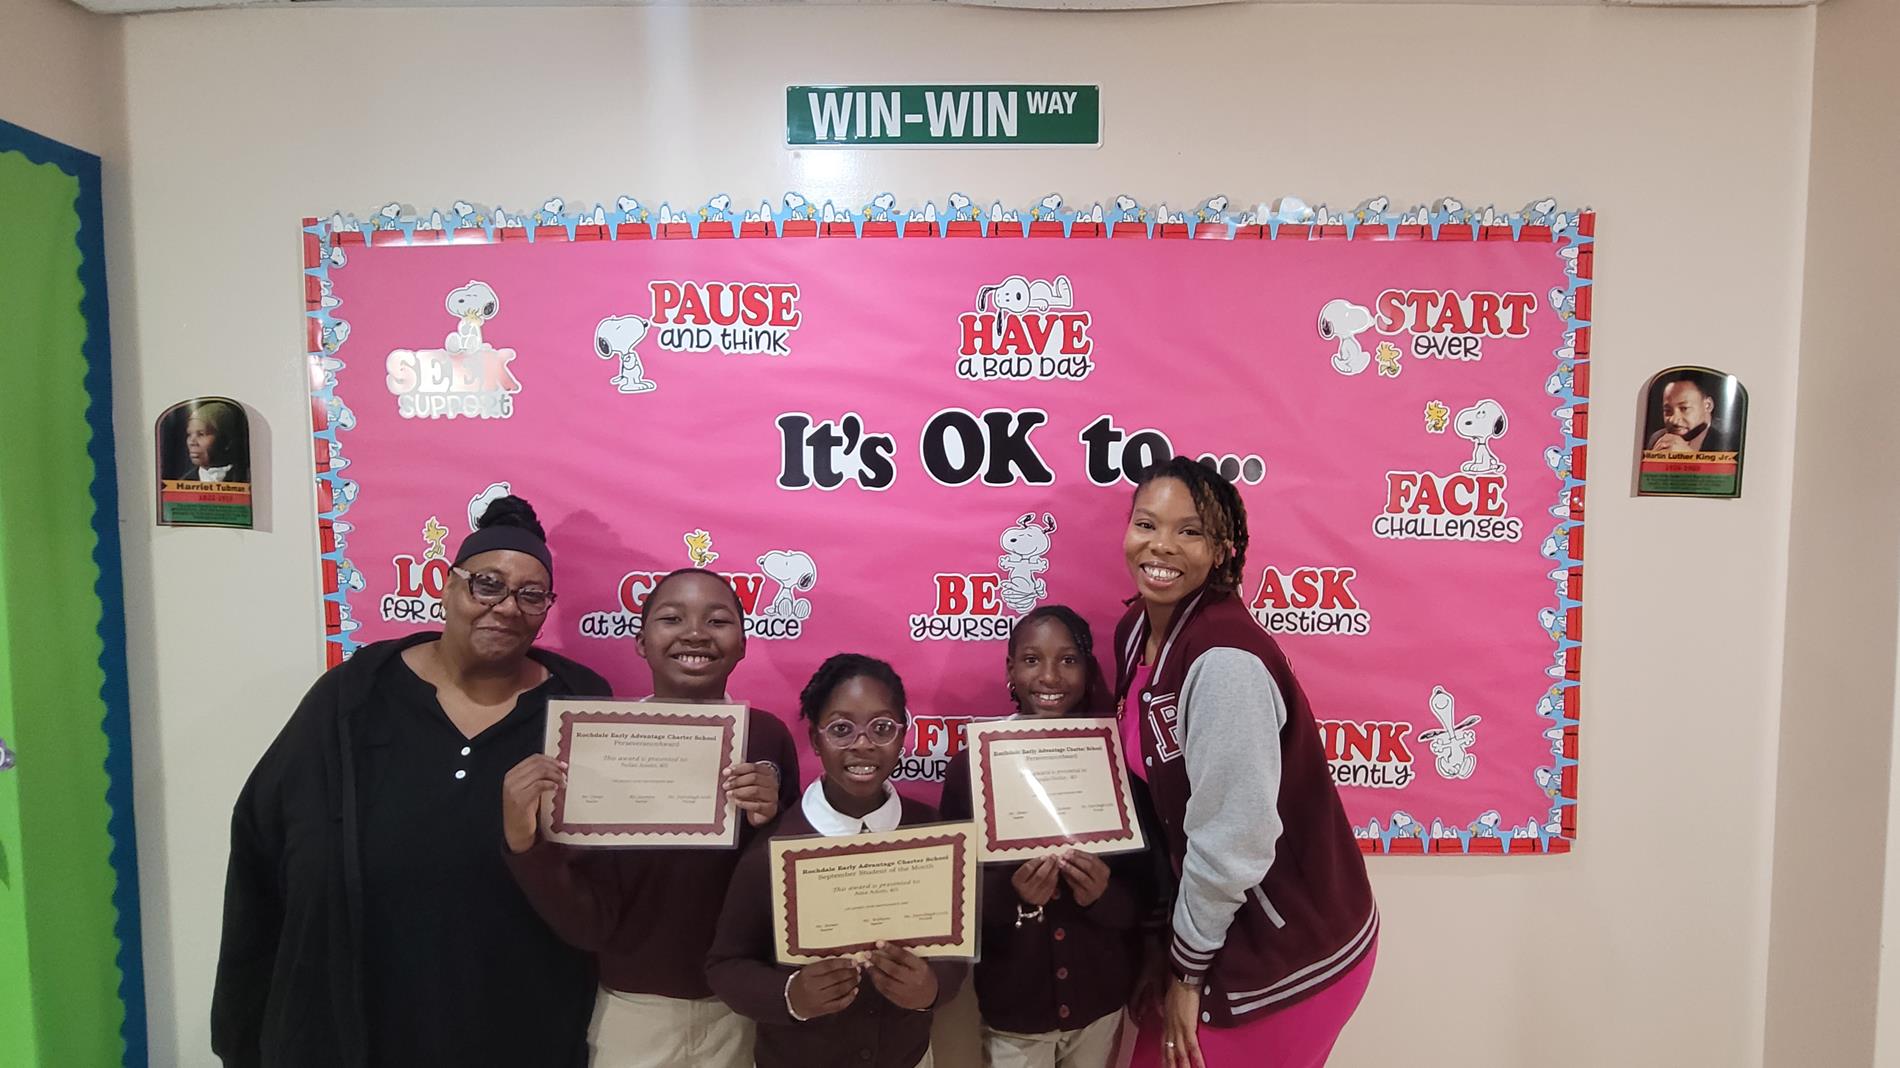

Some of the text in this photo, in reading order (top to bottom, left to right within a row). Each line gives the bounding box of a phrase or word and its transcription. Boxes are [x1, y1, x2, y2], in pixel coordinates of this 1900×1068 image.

[808, 91, 1078, 139] WIN-WIN WAY
[650, 282, 800, 327] PAUSE
[1377, 291, 1536, 335] START
[960, 314, 1091, 355] HAVE
[387, 350, 520, 392] SEEK
[778, 414, 895, 489] It's
[922, 410, 1053, 485] OK
[1081, 416, 1171, 484] to
[1386, 473, 1505, 516] FACE
[395, 557, 449, 599] LO
[936, 575, 1001, 615] BE
[1252, 568, 1357, 609] ASK
[582, 615, 610, 636] at
[1254, 610, 1368, 633] uestions
[1316, 722, 1412, 762] INK
[802, 866, 835, 874] Rochdale
[858, 861, 895, 869] Advantage
